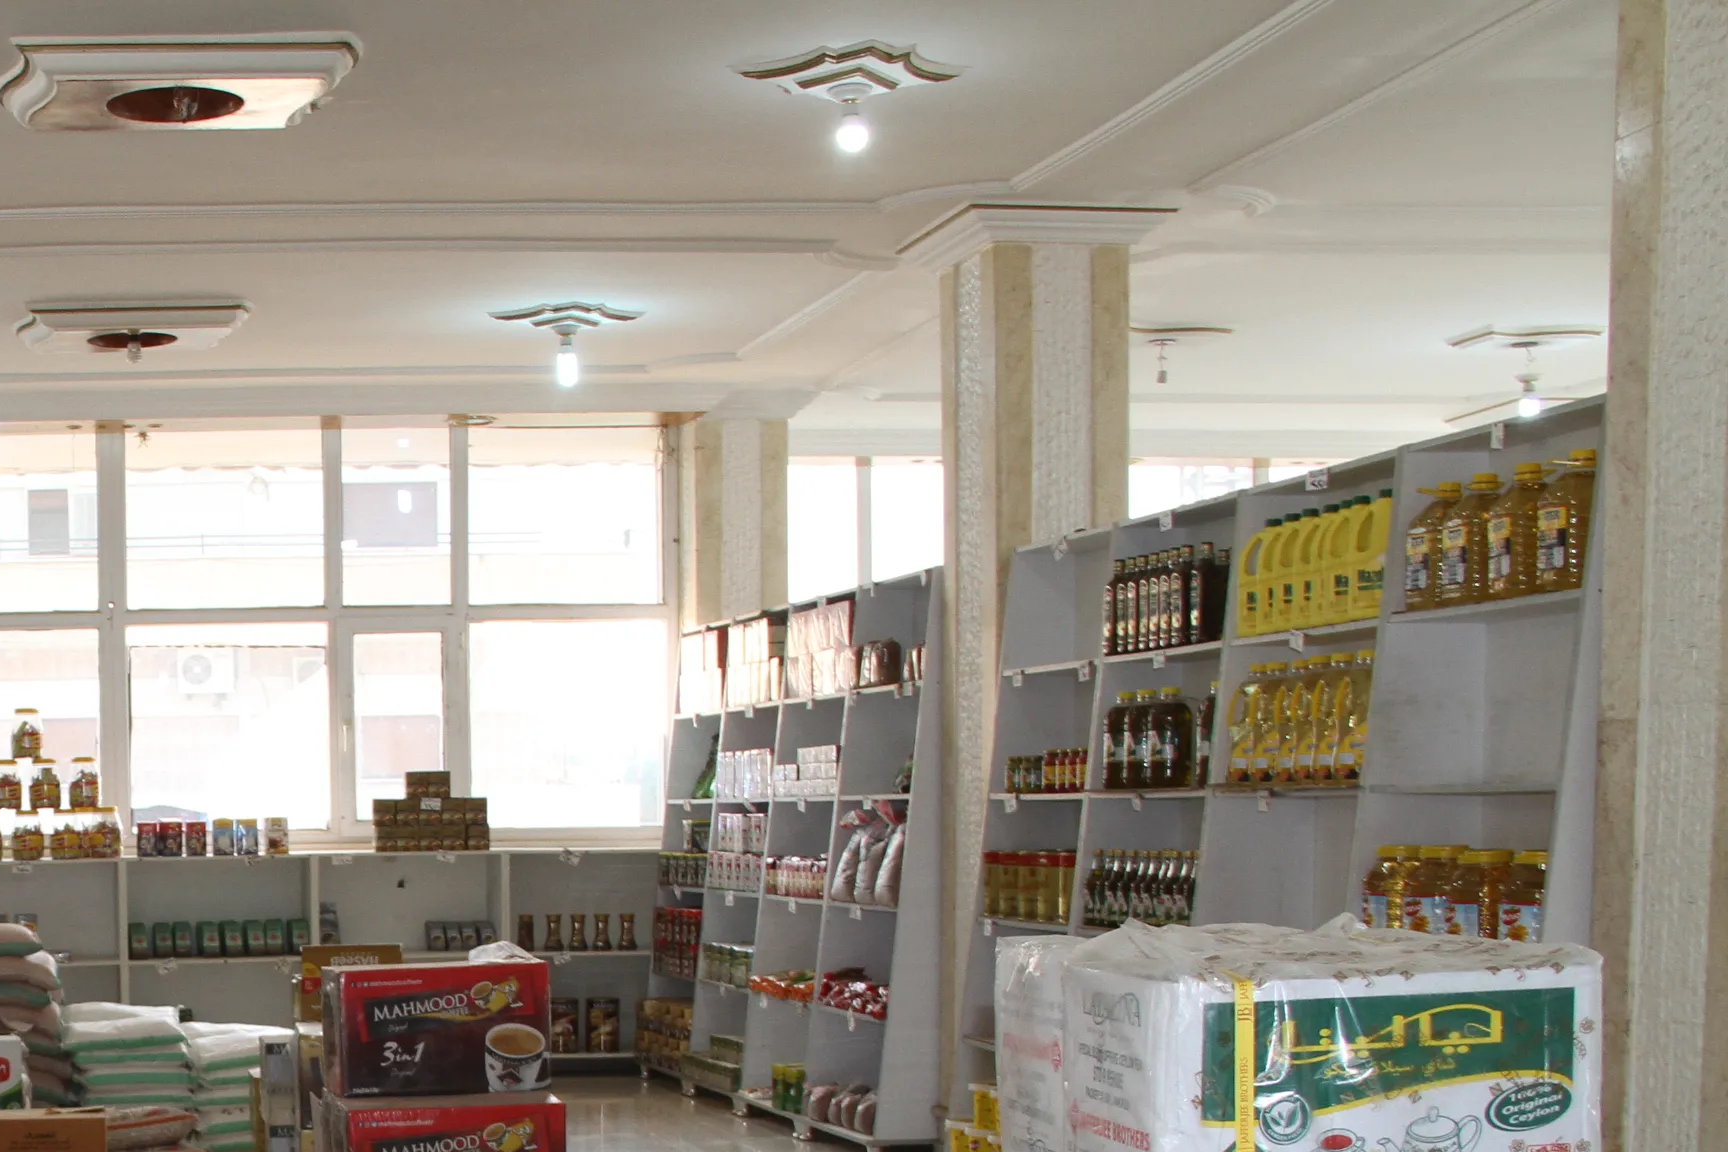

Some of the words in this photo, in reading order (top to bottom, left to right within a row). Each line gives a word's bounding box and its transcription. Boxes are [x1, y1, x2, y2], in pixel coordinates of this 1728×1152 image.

[373, 993, 468, 1022] MAHMOOD
[1502, 1093, 1564, 1114] Original
[1509, 1104, 1561, 1125] Ceylon
